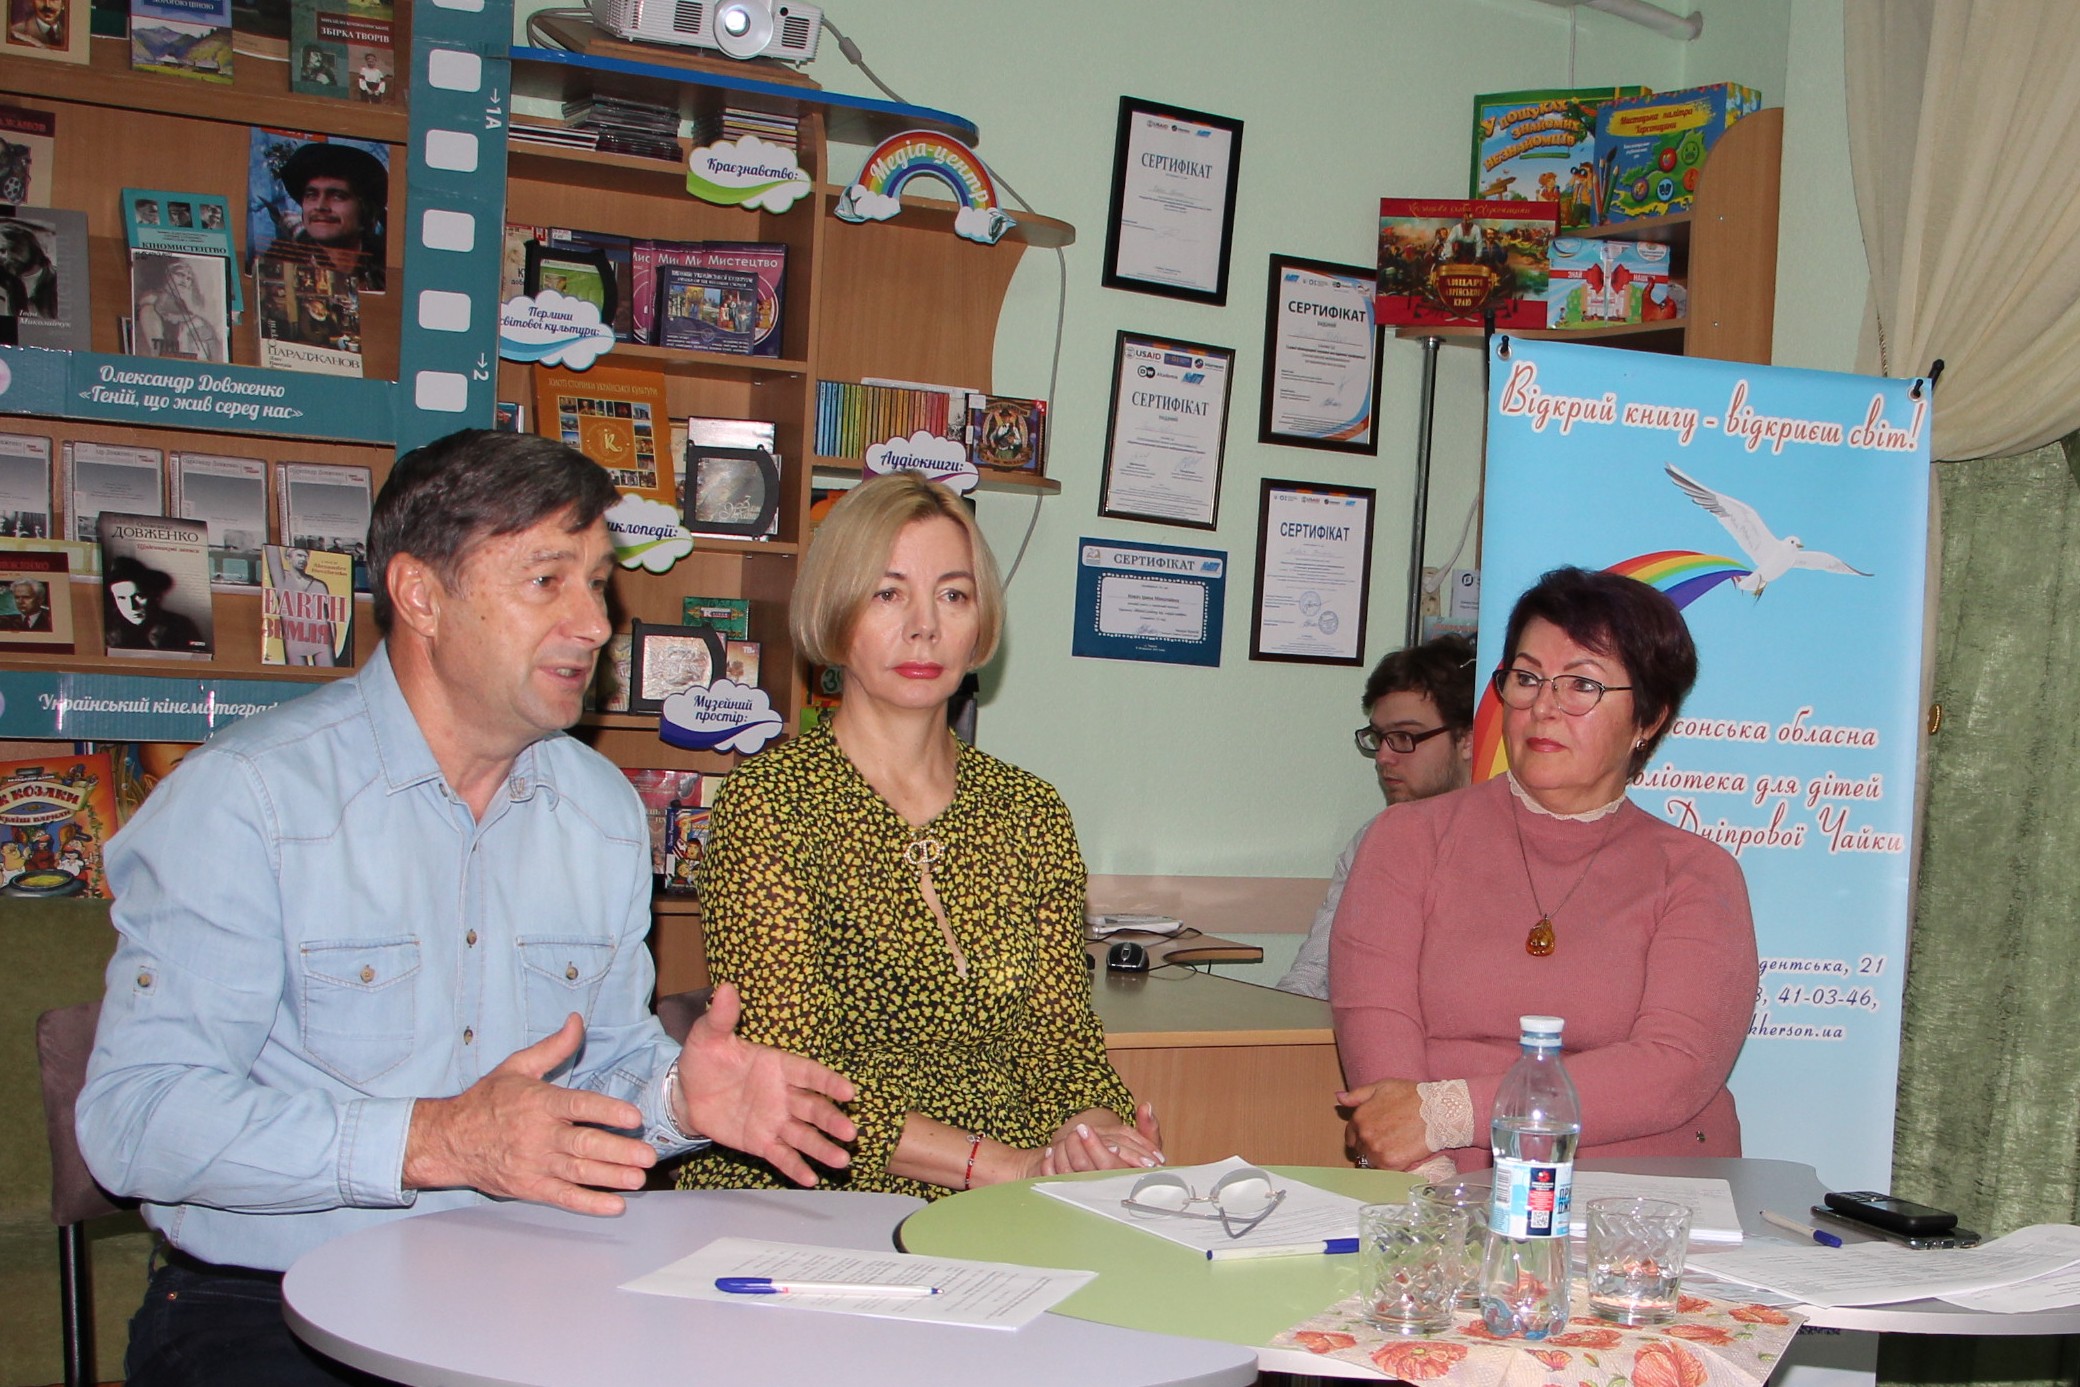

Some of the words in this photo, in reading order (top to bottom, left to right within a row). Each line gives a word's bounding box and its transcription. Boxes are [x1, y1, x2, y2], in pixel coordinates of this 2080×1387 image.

[320, 27, 354, 38] ЗБІРКА
[354, 31, 390, 43] ТВОРІВ
[707, 158, 798, 180] Краєзнавство:
[870, 140, 988, 202] Медіа-центр
[1141, 152, 1212, 179] СЕРТИФІКАТ
[142, 242, 227, 254] КІНОМИСТЕЦТВО
[708, 255, 778, 268] Мистецтво
[528, 306, 573, 322] Перлини
[1288, 300, 1366, 323] СЕРТИФІКАТ
[544, 323, 600, 338] культури:
[268, 347, 361, 370] ПАРАДЖАНОВ
[1135, 349, 1161, 360] USAID
[99, 364, 195, 394] Олександр
[198, 374, 285, 398] Довженко
[78, 385, 140, 409] «Геній,
[143, 394, 170, 412] що
[173, 395, 213, 413] жив
[215, 402, 261, 421] серед
[262, 404, 304, 420] нас»
[1132, 391, 1209, 417] СЕРТИФІКАТ
[1502, 364, 1614, 432] Відкрий
[1625, 406, 1696, 443] книгу
[1726, 383, 1841, 452] відкриєш
[1850, 397, 1924, 449] світ!
[881, 450, 964, 473] Аудіокниги:
[111, 525, 199, 543] ДОВЖЕНКО
[607, 521, 678, 541] иклопедії:
[1280, 522, 1350, 542] СЕРТИФІКАТ
[1113, 553, 1196, 571] СЕРТИФІКАТ
[263, 588, 347, 623] EARTH
[262, 618, 330, 645] ЗЕМЛЯ
[38, 693, 149, 714] Український
[694, 695, 753, 711] Музейний
[695, 711, 748, 726] простір:
[1672, 720, 1767, 740] сонська
[1778, 710, 1877, 746] обласна
[1756, 778, 1798, 805] для
[1808, 774, 1881, 807] дітей
[1667, 800, 1805, 856] Дніпрової
[1818, 806, 1903, 852] Чайки
[1759, 960, 1849, 976] дентська,
[1860, 957, 1884, 974] 21
[1778, 986, 1877, 1010] 41-03-46,
[1748, 1013, 1843, 1038] kherson.ua
